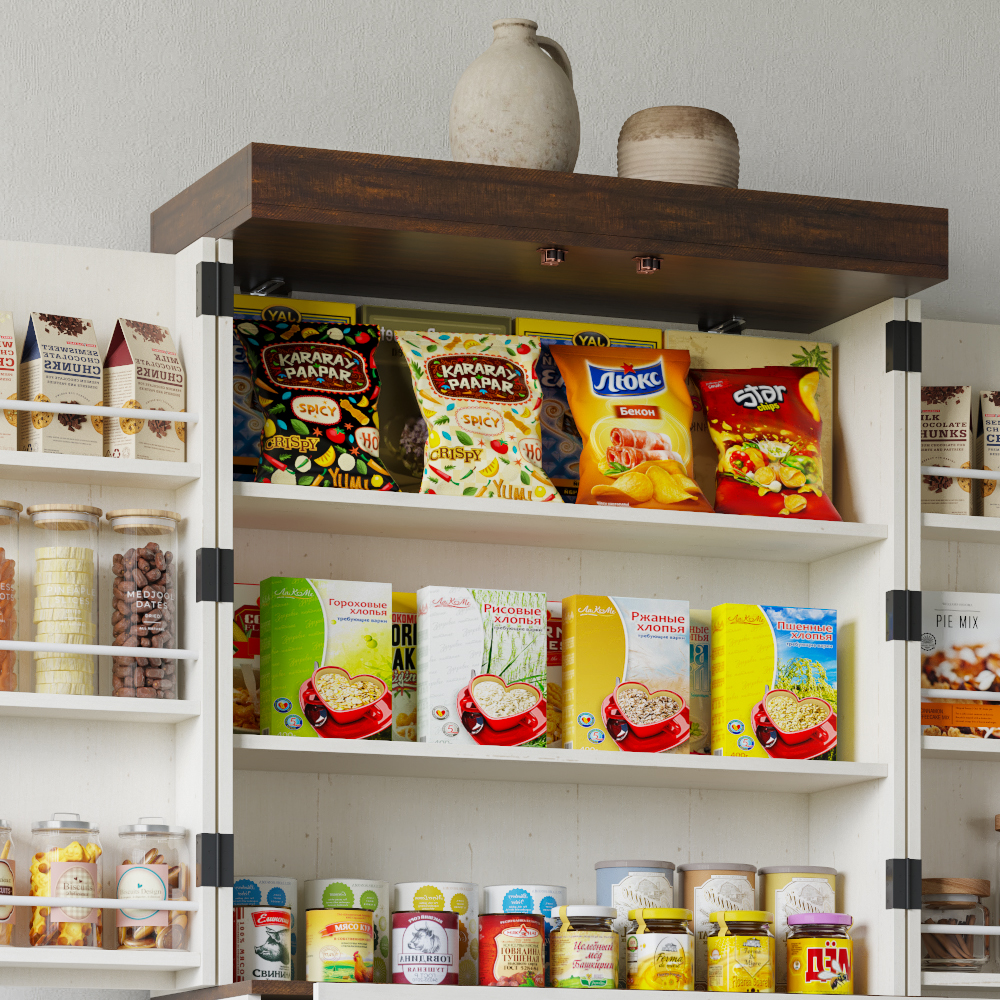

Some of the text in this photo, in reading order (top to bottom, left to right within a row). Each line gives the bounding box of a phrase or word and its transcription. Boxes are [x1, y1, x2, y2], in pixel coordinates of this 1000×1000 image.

[278, 351, 356, 369] KARARAY
[284, 365, 353, 384] PAAPAR
[441, 362, 519, 381] KARARAY
[448, 377, 515, 395] PAAPAR
[299, 402, 337, 418] SPICY
[462, 414, 501, 429] SPICY
[265, 435, 320, 453] CRISPY
[430, 446, 484, 463] CRISPY
[54, 596, 90, 606] SLICES
[126, 590, 175, 601] MEDJOOL
[135, 600, 168, 610] DATES
[329, 598, 387, 609] Гороховые
[349, 608, 387, 616] хлопья
[484, 604, 542, 616] Рисовые
[494, 615, 541, 625] хлопья
[631, 611, 685, 624] Ржаные
[936, 614, 979, 629] PIE MIX
[637, 623, 685, 634] хлопья
[777, 621, 833, 634] Пшенные
[790, 632, 833, 642] хлопья
[63, 882, 93, 892] Biscuits
[333, 923, 359, 933] МЯСО
[501, 947, 540, 955] ГОВЯДИНА
[656, 952, 684, 963] Ferma
